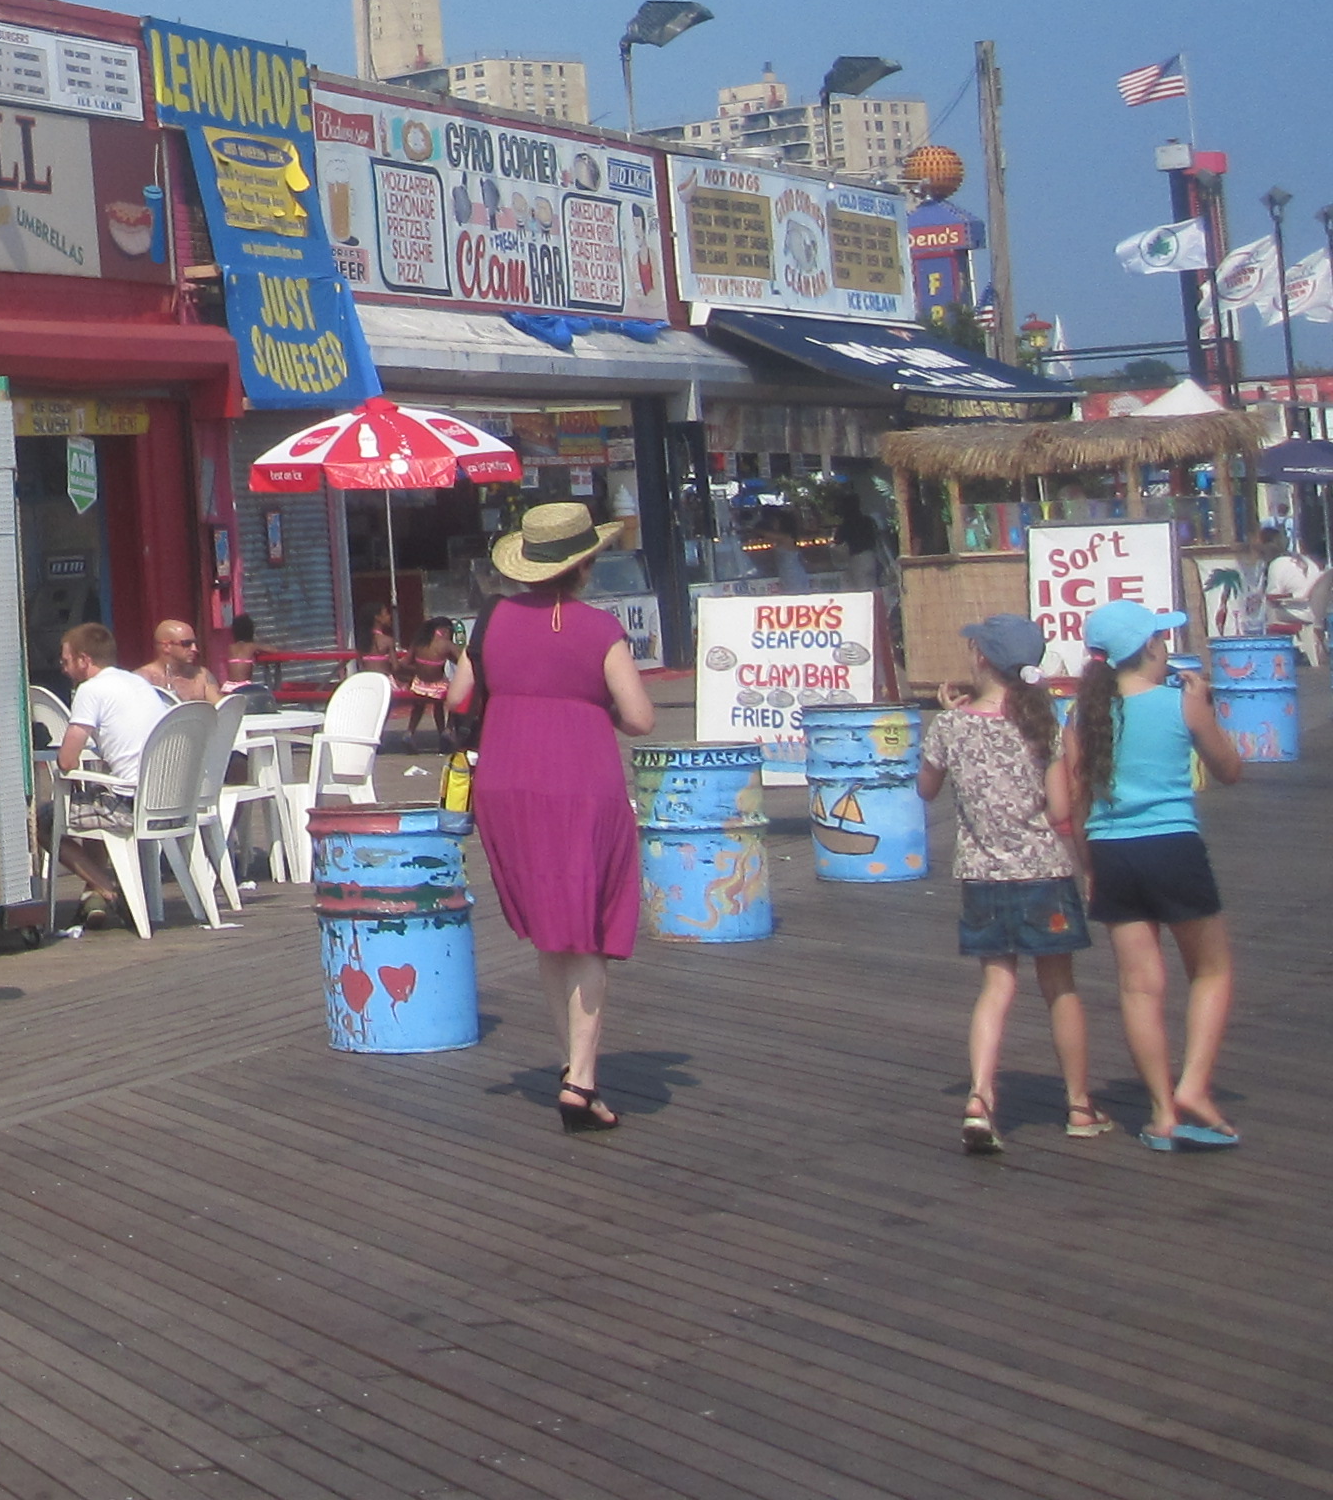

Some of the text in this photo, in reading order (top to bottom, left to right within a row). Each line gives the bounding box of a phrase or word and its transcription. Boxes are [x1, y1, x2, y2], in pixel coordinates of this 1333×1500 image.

[150, 29, 313, 132] LEMONADE
[316, 109, 370, 146] Budweiser
[445, 121, 494, 174] GYRO
[729, 171, 760, 193] DOGS
[385, 192, 436, 220] LEMONADE
[571, 200, 593, 220] BAKED
[15, 206, 85, 267] UMBRELLAS
[387, 216, 432, 240] PRETZELS
[392, 238, 433, 263] SLUSHIE
[397, 261, 425, 284] PIZZA
[456, 229, 566, 307] Clam BAR
[258, 272, 316, 330] JUST
[251, 325, 348, 394] SQUEEZED
[1049, 530, 1129, 578] Soft
[1038, 575, 1145, 608] ICE
[756, 598, 843, 630] RUBY'S
[751, 630, 842, 650] SEAFOOD
[737, 663, 850, 690] CLAM BAR
[731, 707, 784, 729] FRIED
